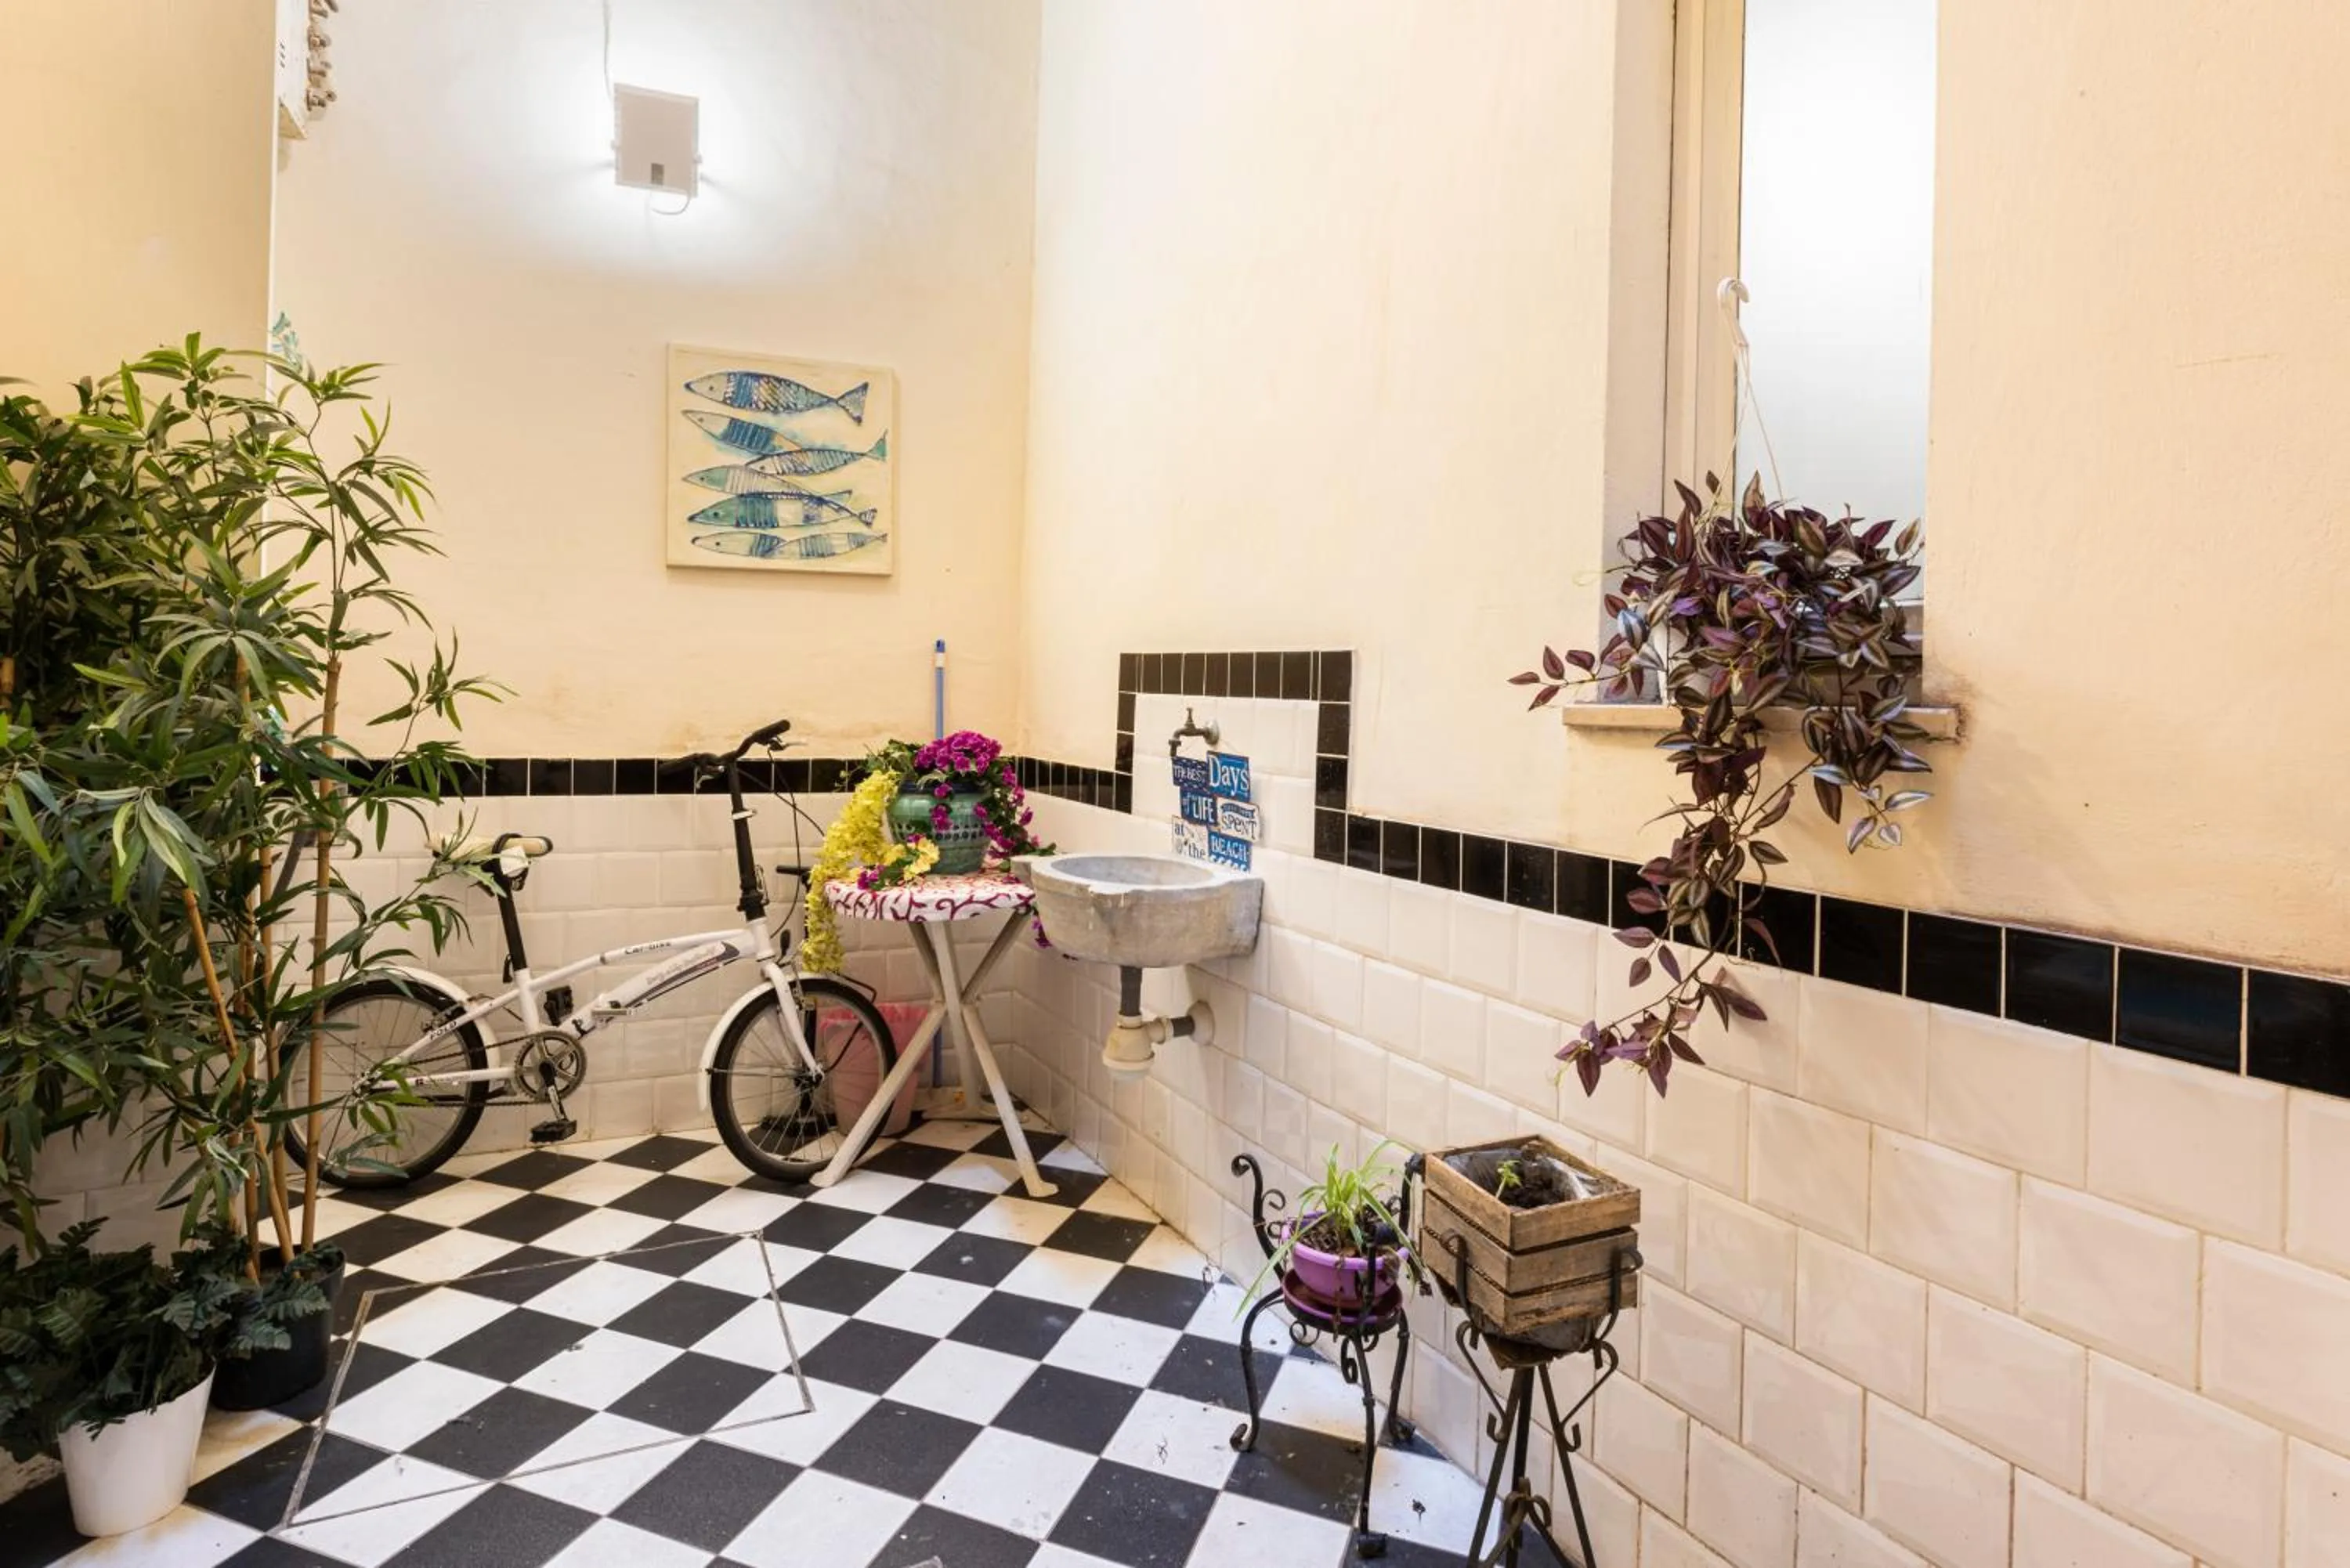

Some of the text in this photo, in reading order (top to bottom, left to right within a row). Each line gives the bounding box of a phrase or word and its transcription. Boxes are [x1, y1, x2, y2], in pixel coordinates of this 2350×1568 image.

[1209, 754, 1249, 797] Days
[1192, 795, 1214, 823] LIFE
[1175, 822, 1184, 836] at
[1188, 842, 1206, 859] the
[1210, 834, 1248, 862] BEACH
